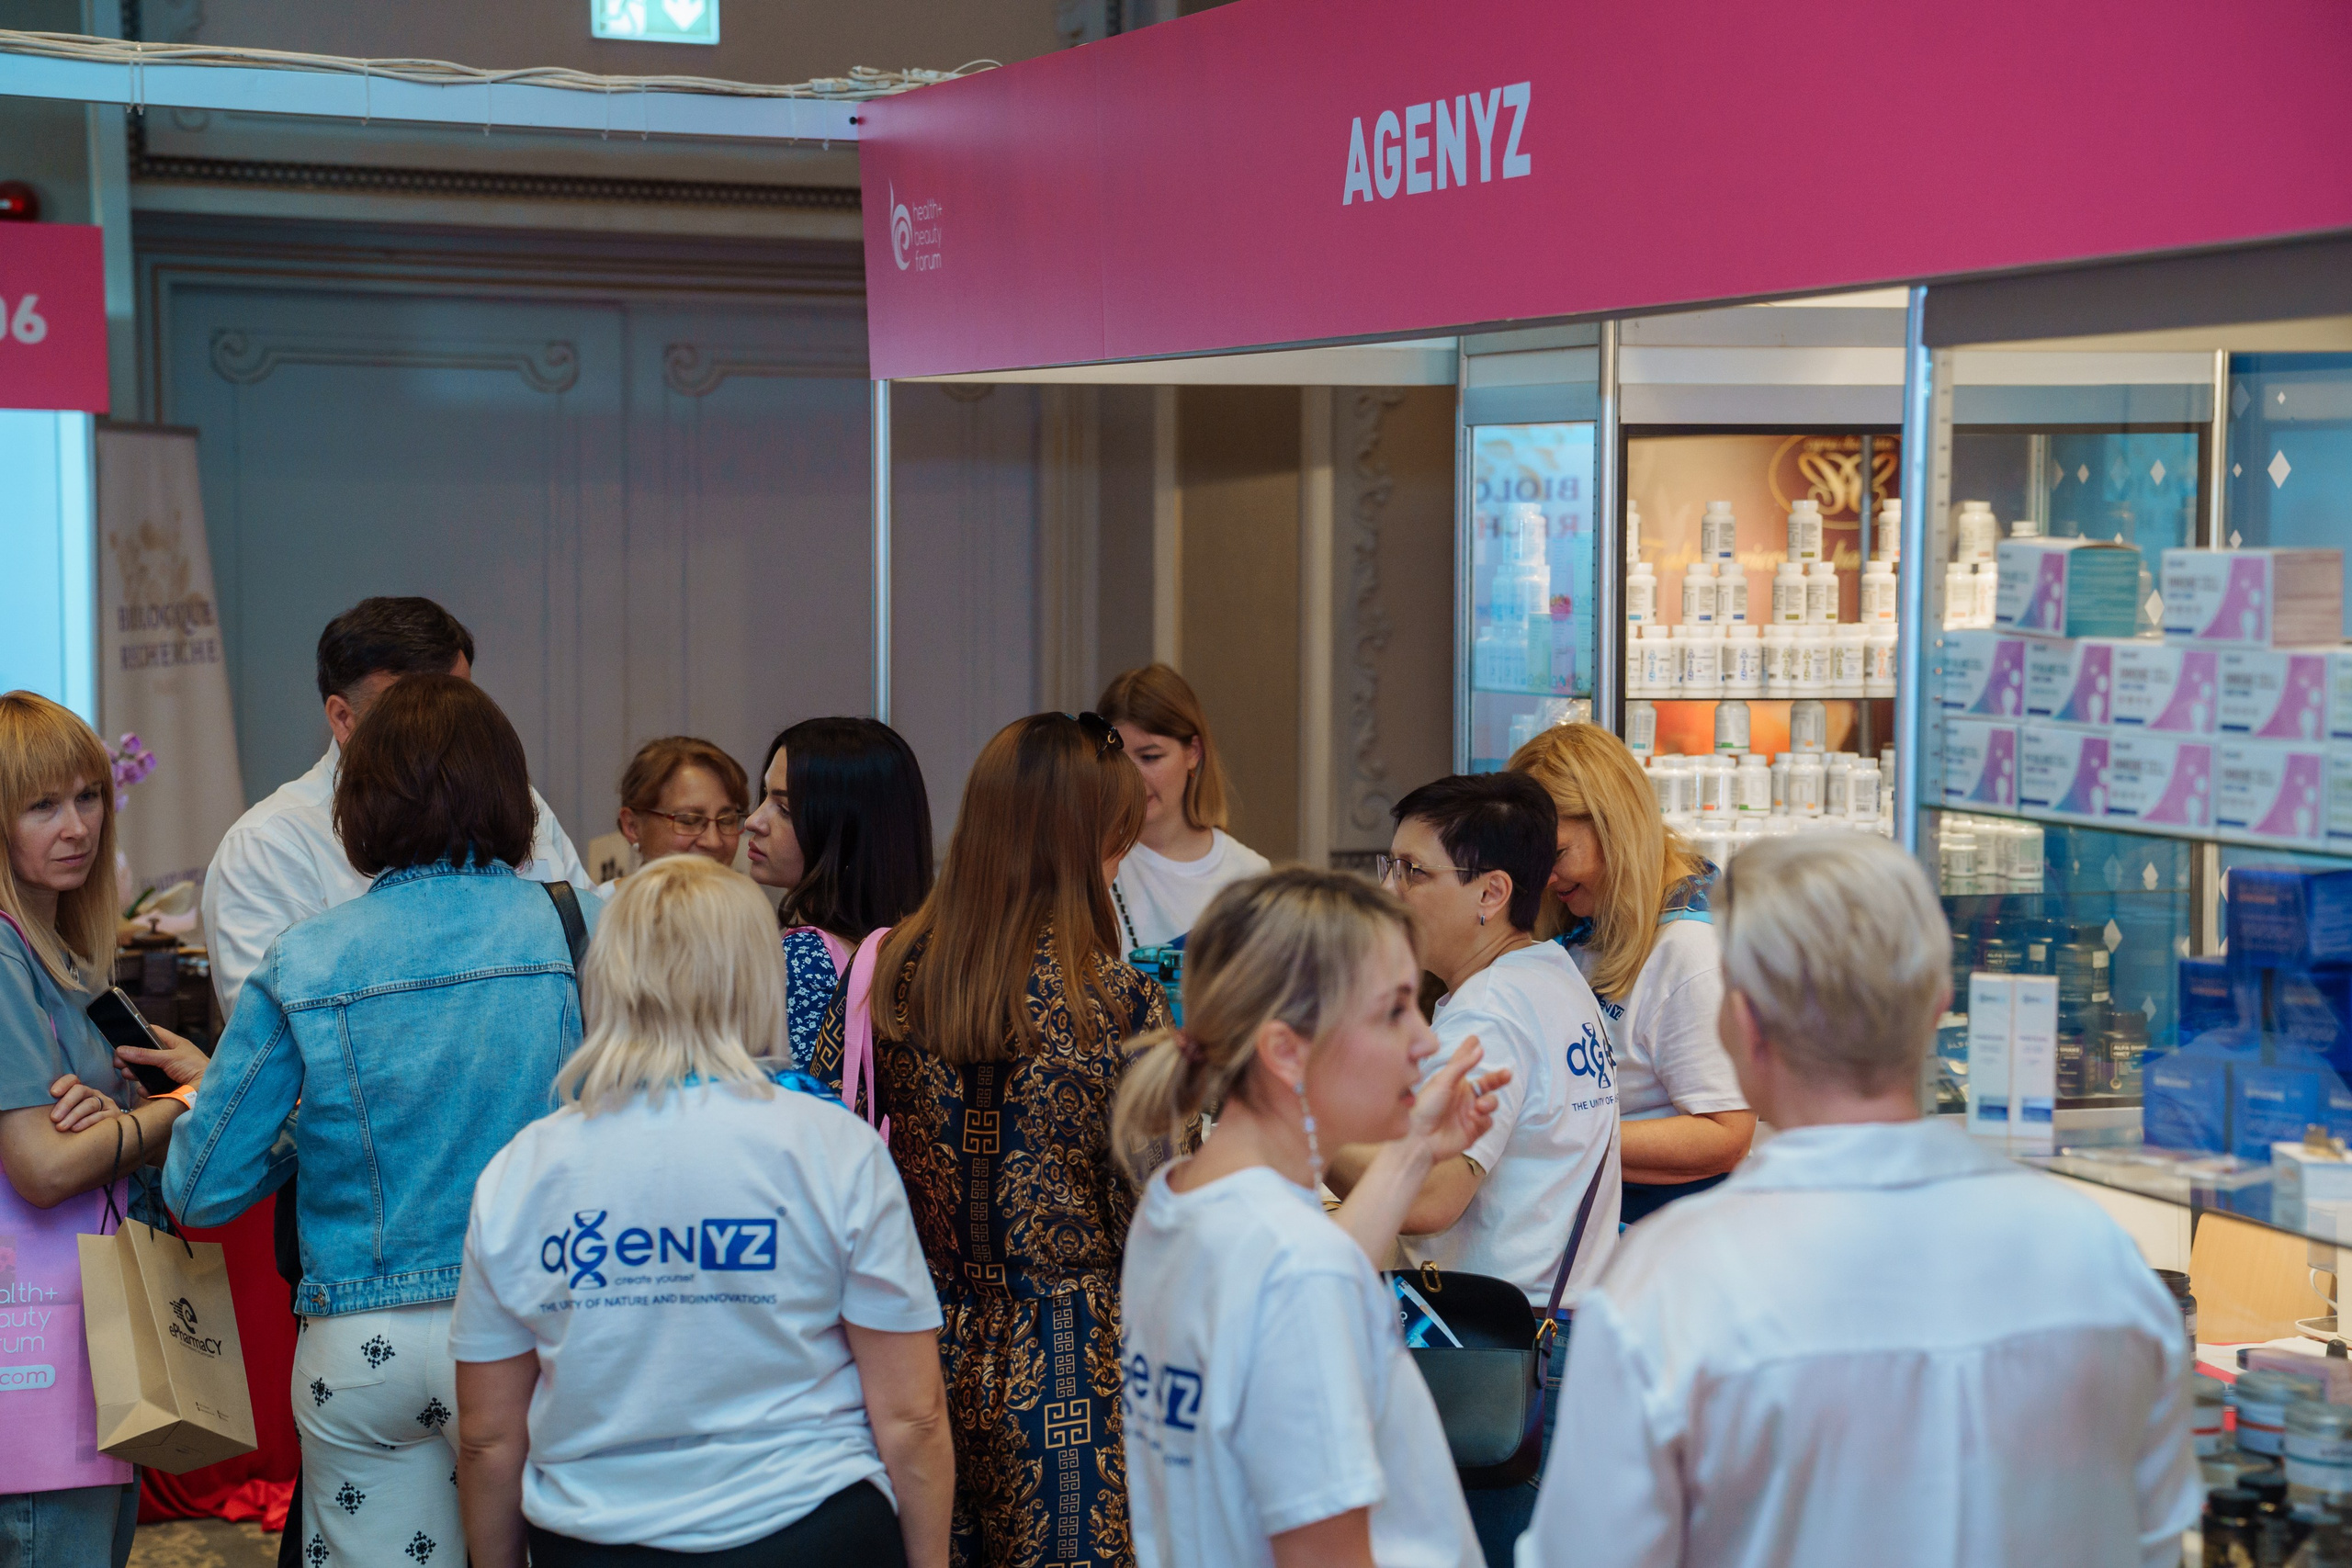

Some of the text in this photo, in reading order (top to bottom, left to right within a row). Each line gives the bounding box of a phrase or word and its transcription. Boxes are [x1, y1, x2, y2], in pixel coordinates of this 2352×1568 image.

[1342, 81, 1532, 206] AGENYZ
[912, 198, 943, 220] health+
[912, 224, 943, 249] beauty
[914, 250, 943, 271] forum
[1572, 1100, 1589, 1111] THE
[1605, 1095, 1614, 1105] OF
[615, 1276, 651, 1286] create
[585, 1297, 601, 1309] OF
[605, 1294, 649, 1307] NATURE
[652, 1293, 678, 1305] AND
[169, 1322, 222, 1356] ePharmaCY
